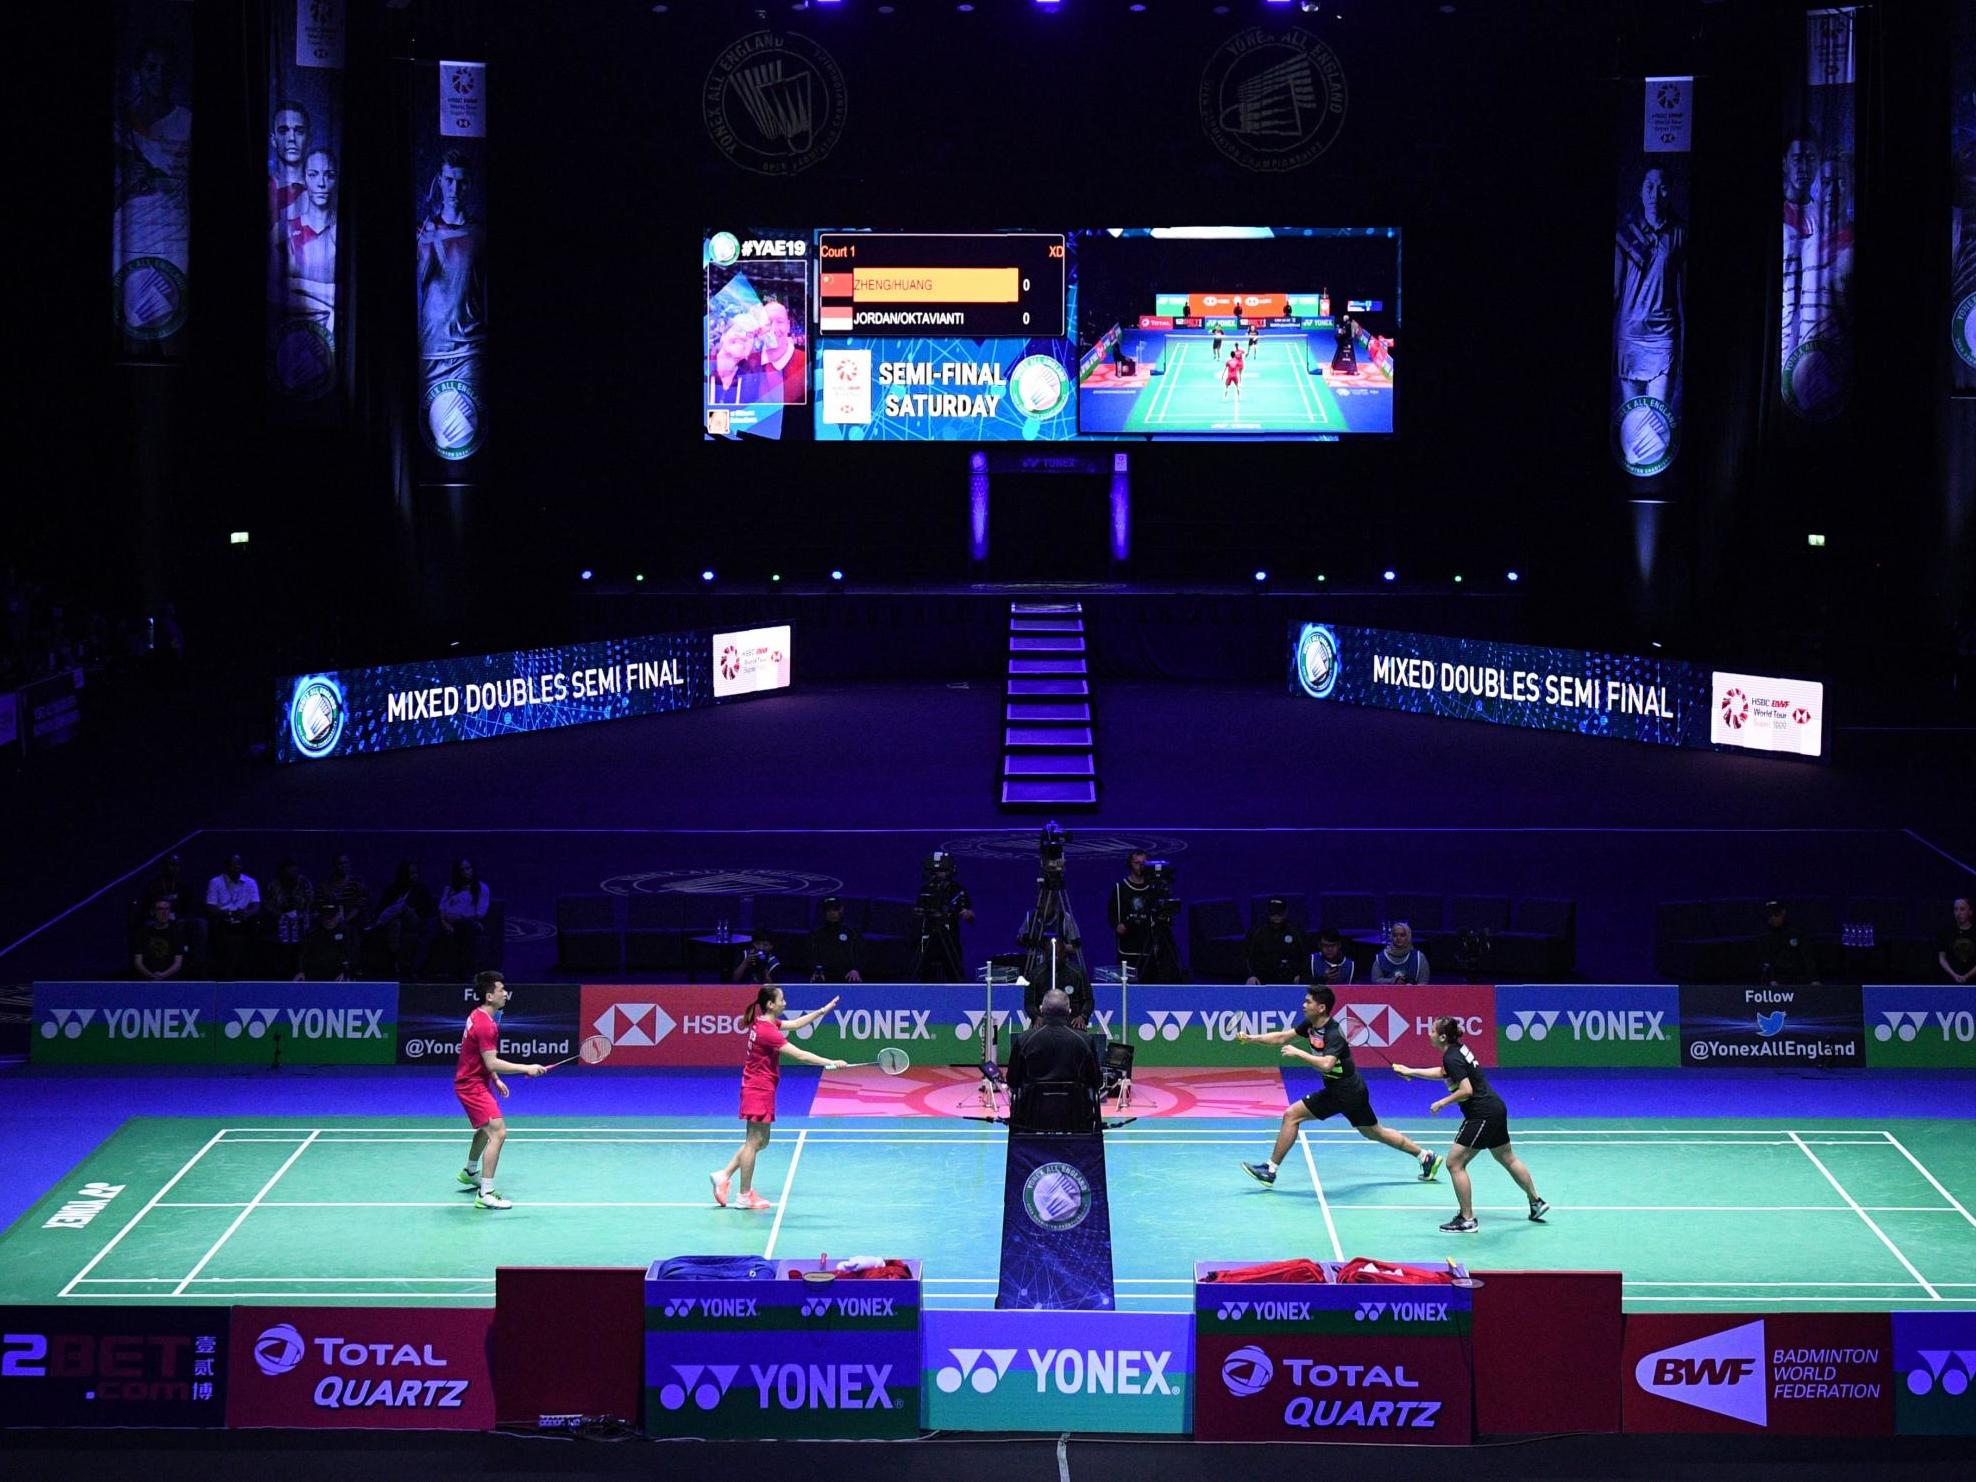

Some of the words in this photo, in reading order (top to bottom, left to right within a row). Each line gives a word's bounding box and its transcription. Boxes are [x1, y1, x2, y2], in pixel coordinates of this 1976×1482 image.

[741, 240, 806, 257] #YAE19
[820, 246, 848, 258] Court
[850, 246, 855, 258] 1
[1049, 246, 1064, 258] XD
[854, 279, 933, 291] ZHENG/HUANG
[1023, 279, 1030, 291] 0
[853, 312, 965, 326] JORDAN/OKTAVIANTI
[1023, 312, 1030, 325] 0
[879, 362, 1007, 386] SEMI-FINAL
[885, 394, 1000, 418] SATURDAY
[387, 686, 459, 723] MIXED
[465, 673, 568, 713] DOUBLES
[571, 667, 621, 699] SEMI
[627, 659, 684, 690] FINAL
[1373, 655, 1434, 690] MIXED
[1441, 663, 1540, 702] DOUBLES
[1545, 675, 1600, 710] SEMI
[1607, 681, 1674, 719] FINAL
[1753, 708, 1772, 718] World
[1745, 990, 1794, 1003] Follow
[103, 1008, 200, 1039] YONEX
[286, 1008, 384, 1039] YONEX
[683, 1015, 750, 1035] HSBC
[834, 1009, 931, 1040] YONEX
[1200, 1010, 1297, 1041] YONEX
[1416, 1016, 1483, 1036] HBC
[1567, 1010, 1665, 1041] YONEX
[1690, 1041, 1856, 1060] @YonexAllEngland
[700, 1298, 758, 1317] YONEX
[836, 1298, 894, 1317] YONEX
[1253, 1301, 1311, 1321] YONEX
[1390, 1302, 1449, 1322] YONEX
[313, 1337, 447, 1367] TOTAL
[1773, 1349, 1879, 1365] BADMINTON
[1027, 1348, 1172, 1396] YONEX
[1282, 1359, 1419, 1388] TOTAL
[1652, 1358, 1756, 1386] BWF
[1773, 1367, 1837, 1382] WORLD
[313, 1376, 468, 1409] QUARTZ
[750, 1363, 894, 1410] YONEX
[1773, 1384, 1881, 1399] FEDERATION
[1283, 1396, 1443, 1428] QUARTZ
